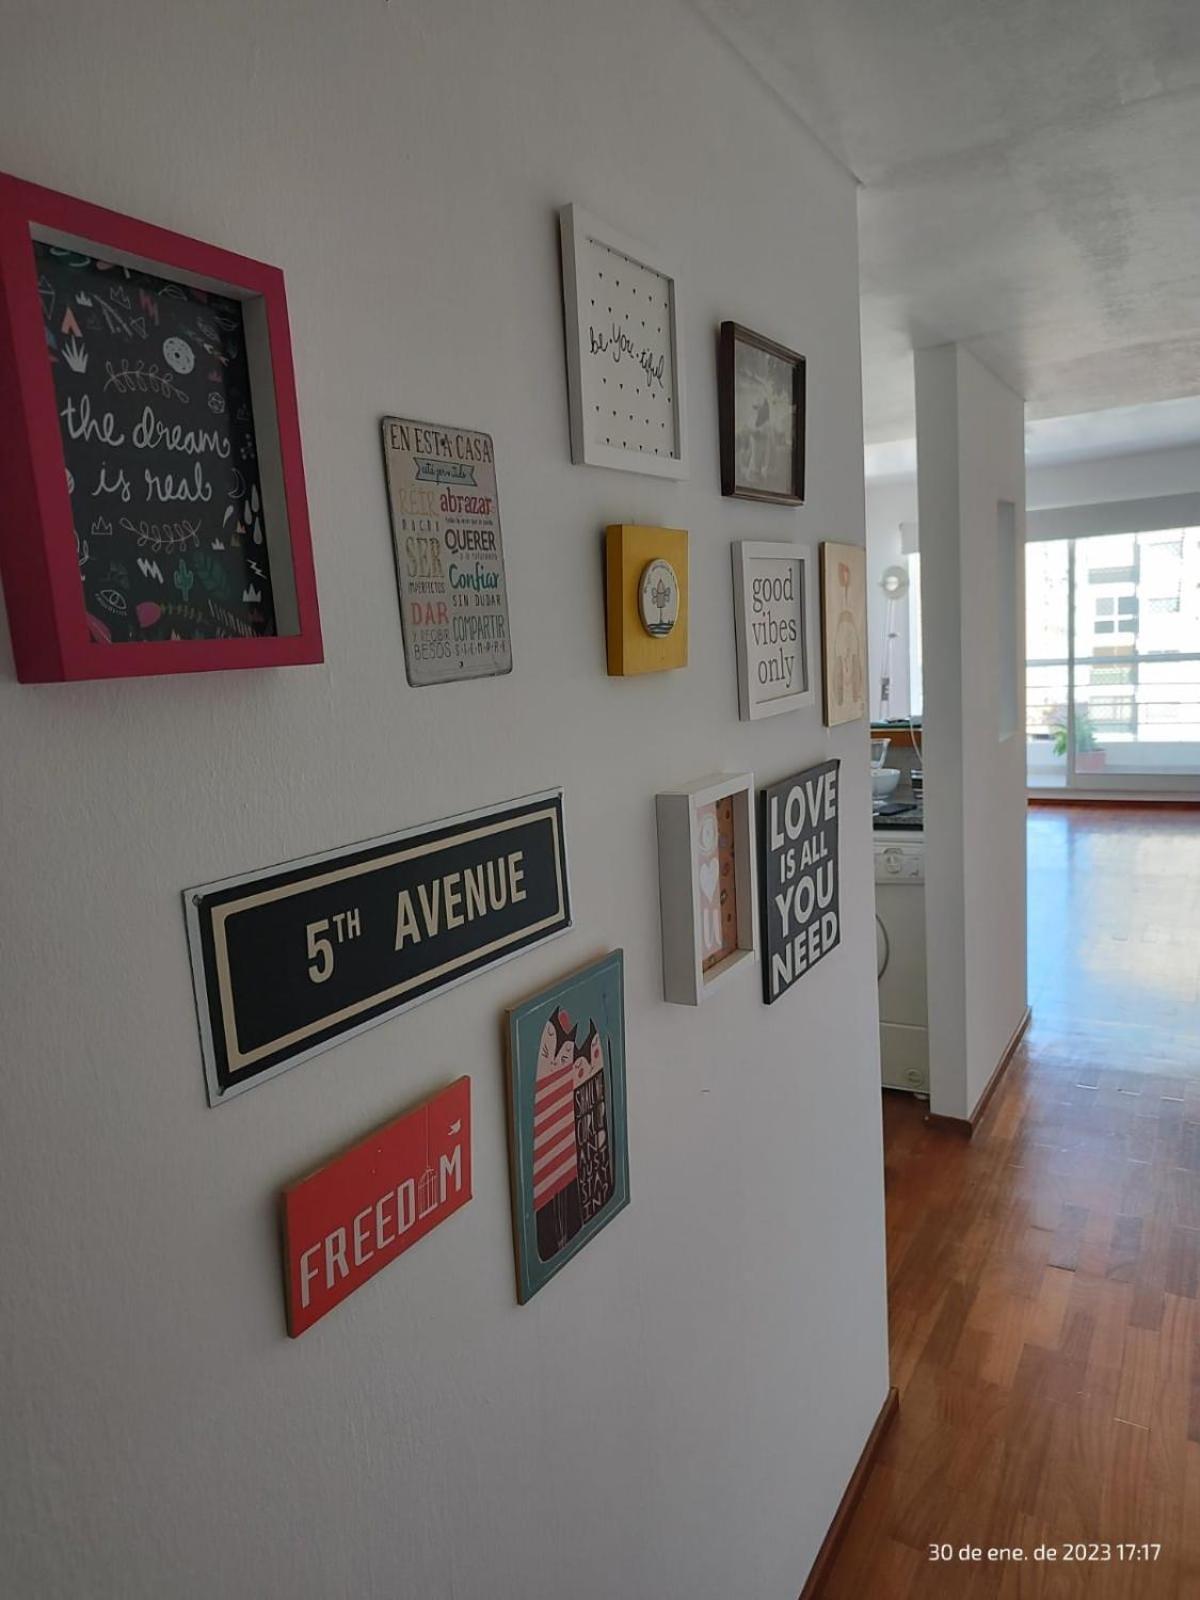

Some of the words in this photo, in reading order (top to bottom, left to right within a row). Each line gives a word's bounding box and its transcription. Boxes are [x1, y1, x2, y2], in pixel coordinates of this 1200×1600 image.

[60, 394, 125, 446] the
[132, 406, 231, 459] dream
[390, 424, 410, 451] EN
[414, 428, 453, 458] ESTA
[456, 434, 492, 463] CASA
[92, 461, 131, 502] is
[144, 461, 212, 502] real
[440, 486, 492, 515] abrazar
[406, 537, 444, 577] SER
[445, 529, 497, 554] QUERER
[449, 561, 499, 592] Confiar
[752, 568, 794, 613] good
[410, 601, 449, 626] DAR
[452, 594, 469, 607] SIN
[452, 614, 506, 642] COMPARTIR
[752, 611, 797, 645] vibes
[414, 640, 452, 660] BESOS
[758, 648, 795, 689] only
[771, 770, 836, 851] LOVE
[780, 848, 796, 883] IS
[800, 831, 828, 871] ALL
[395, 851, 527, 951] AVENUE
[775, 860, 834, 938] YOU
[772, 911, 838, 995] NEED
